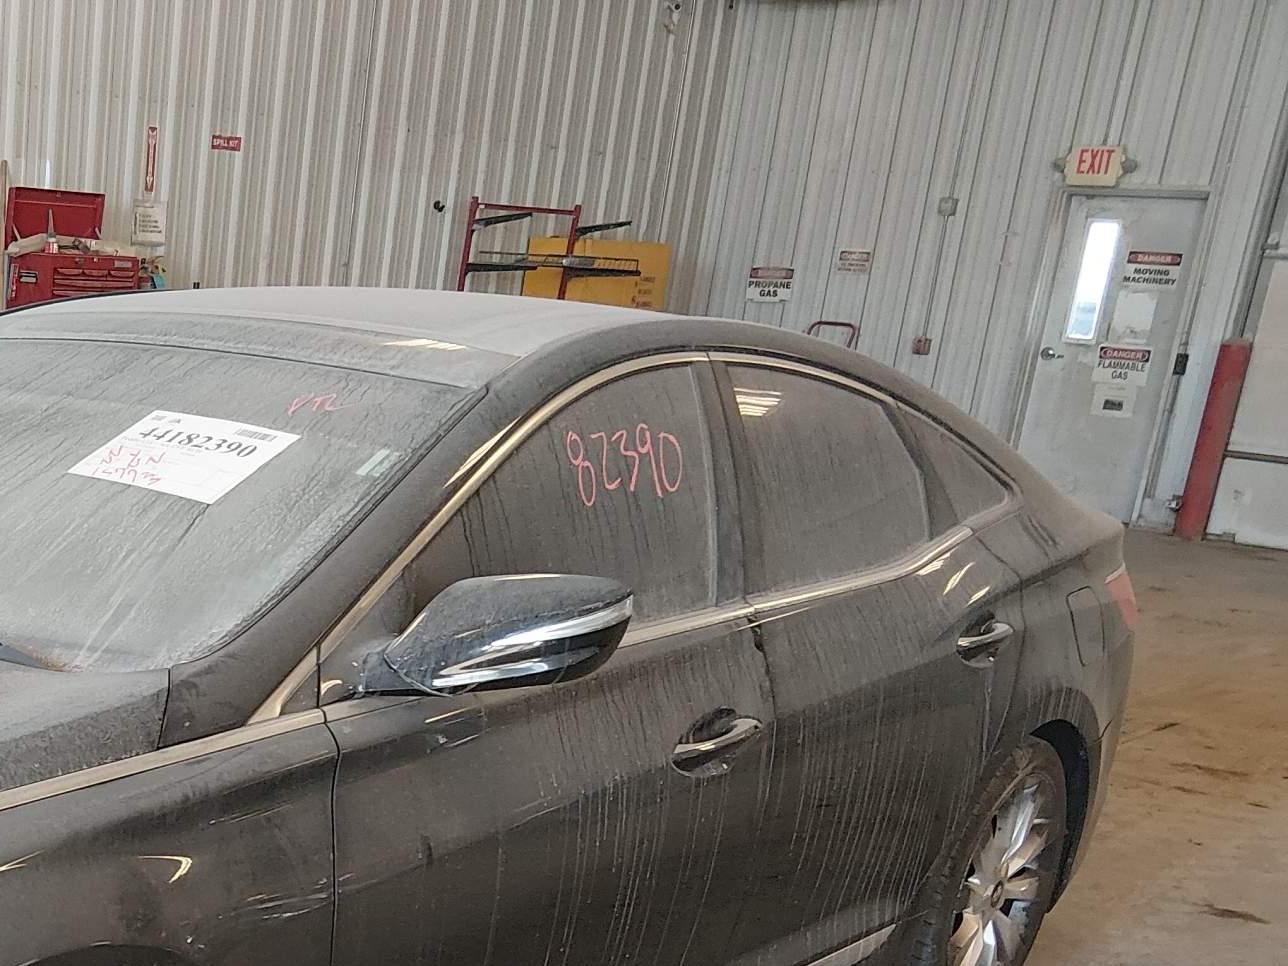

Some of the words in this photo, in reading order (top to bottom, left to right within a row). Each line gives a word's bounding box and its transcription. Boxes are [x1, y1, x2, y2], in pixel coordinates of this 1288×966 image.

[213, 138, 228, 147] SPILL
[1076, 149, 1116, 175] EXIT
[1137, 253, 1172, 263] DANGER
[1133, 268, 1170, 277] MOVING
[748, 280, 792, 290] PROPANE
[1123, 276, 1177, 286] MACHINERY
[759, 289, 778, 298] GAS
[1107, 350, 1144, 361] DANGER
[1098, 360, 1145, 373] FLAMMABLE
[1112, 370, 1129, 381] GAS
[139, 427, 258, 458] 44182390
[566, 423, 683, 507] 82390
